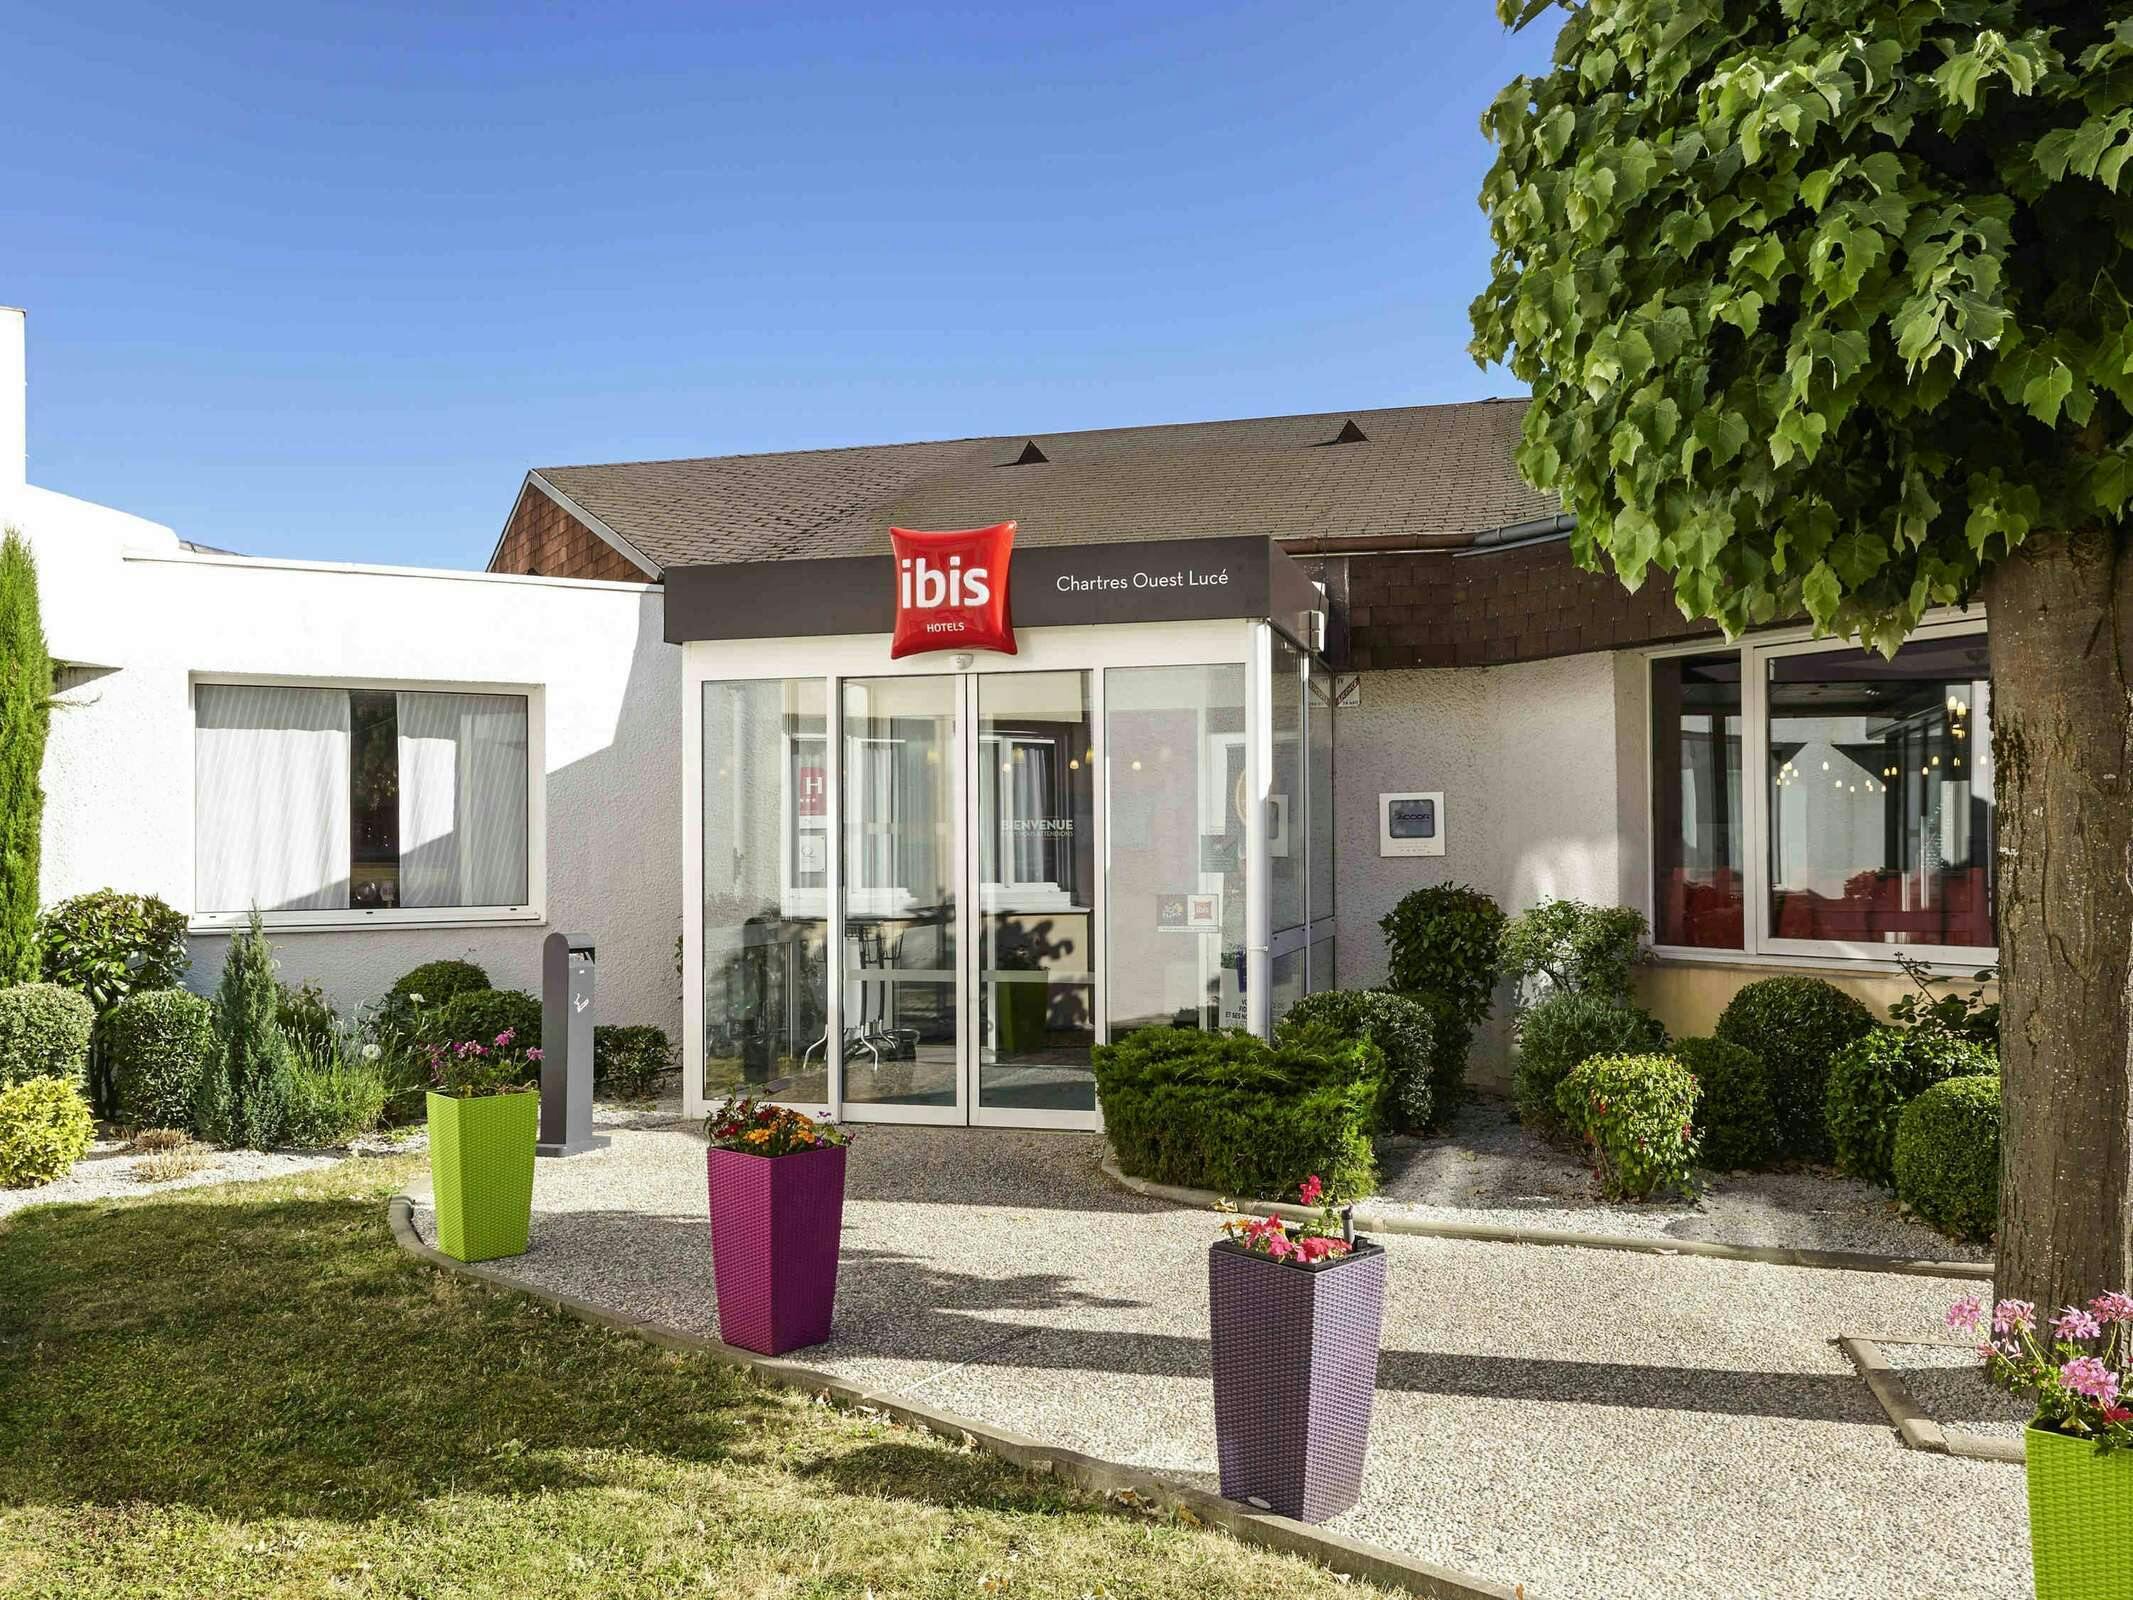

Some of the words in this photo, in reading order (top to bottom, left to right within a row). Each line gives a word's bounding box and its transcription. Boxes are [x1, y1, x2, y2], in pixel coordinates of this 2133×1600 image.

[901, 556, 991, 609] ibis
[1056, 574, 1128, 593] Chartres
[1133, 571, 1184, 589] Ouest
[1188, 567, 1229, 587] Lucé
[926, 621, 965, 634] HOTELS
[805, 776, 823, 794] H
[1001, 819, 1074, 830] BIENVENUE
